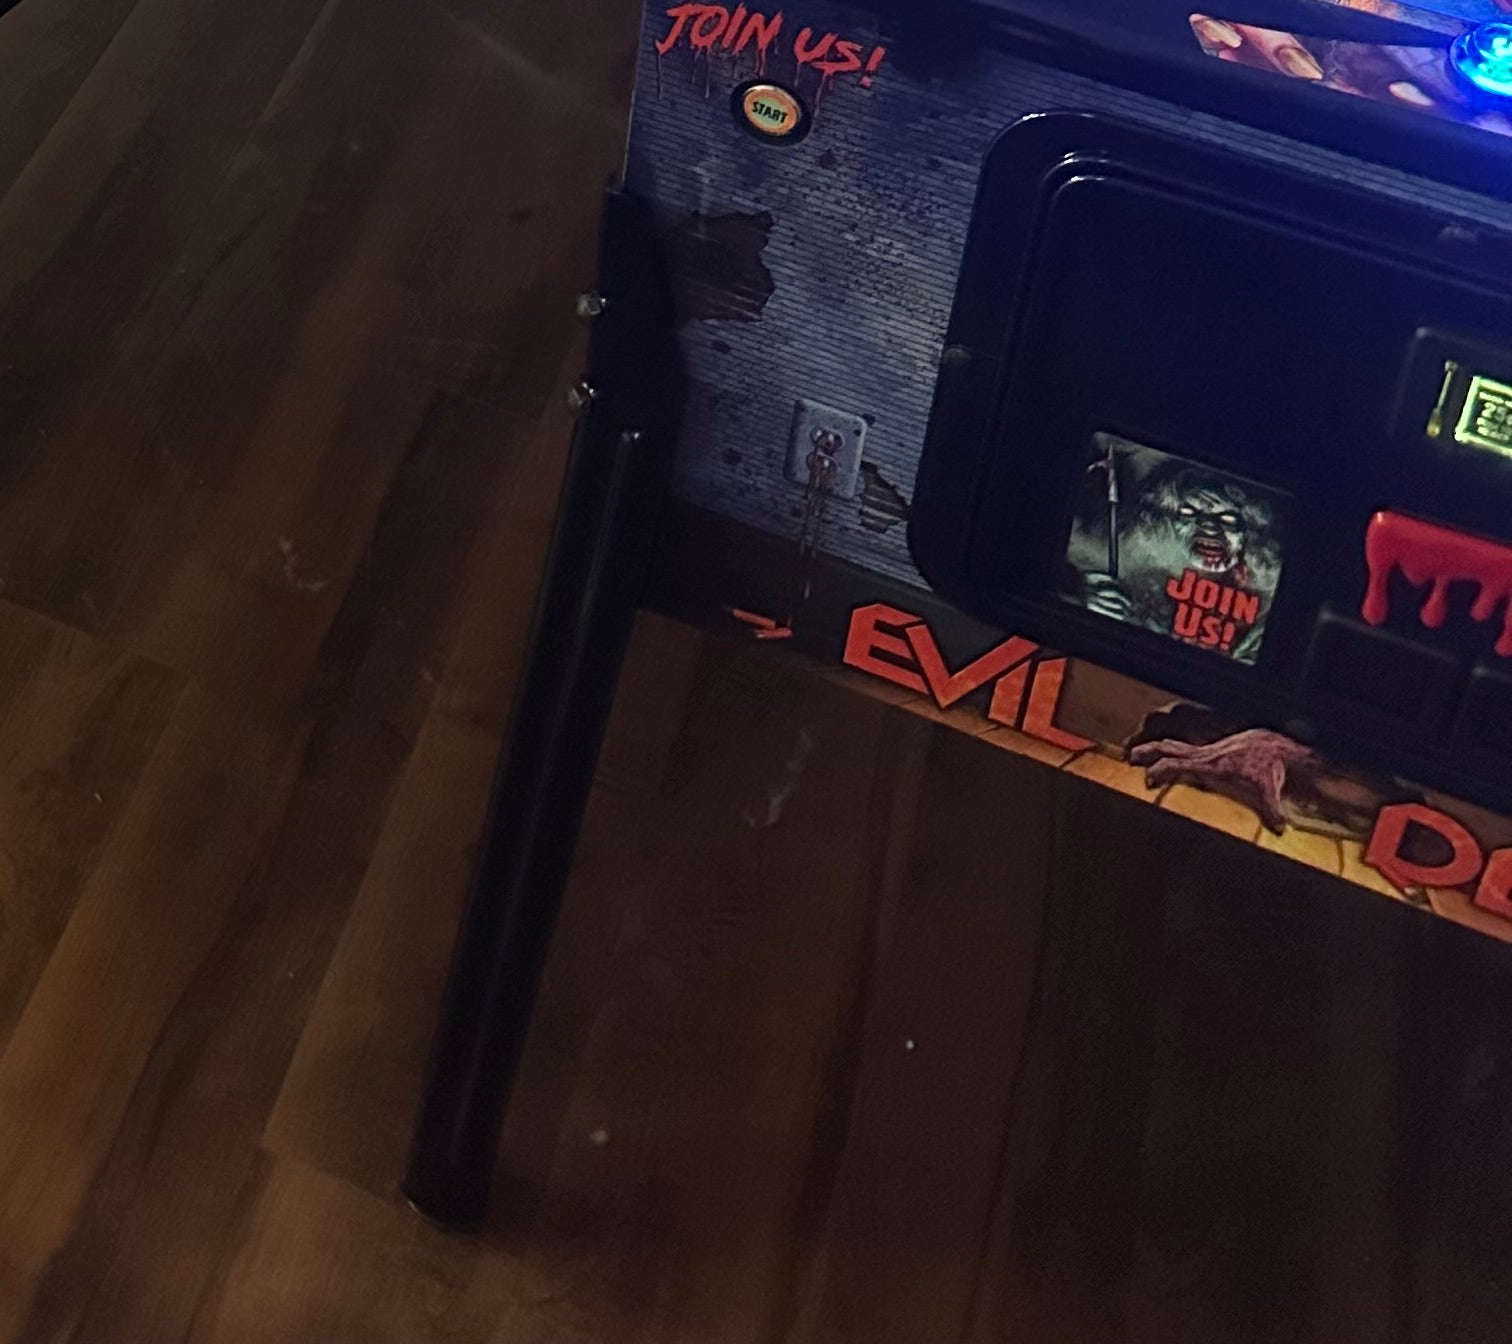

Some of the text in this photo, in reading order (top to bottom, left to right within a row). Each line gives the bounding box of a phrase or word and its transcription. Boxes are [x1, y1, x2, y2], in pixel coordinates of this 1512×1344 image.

[655, 2, 886, 88] JOIN US!
[751, 100, 788, 124] START
[1165, 566, 1260, 626] JOIN
[1173, 601, 1237, 651] US!
[841, 600, 1098, 753] EVIL
